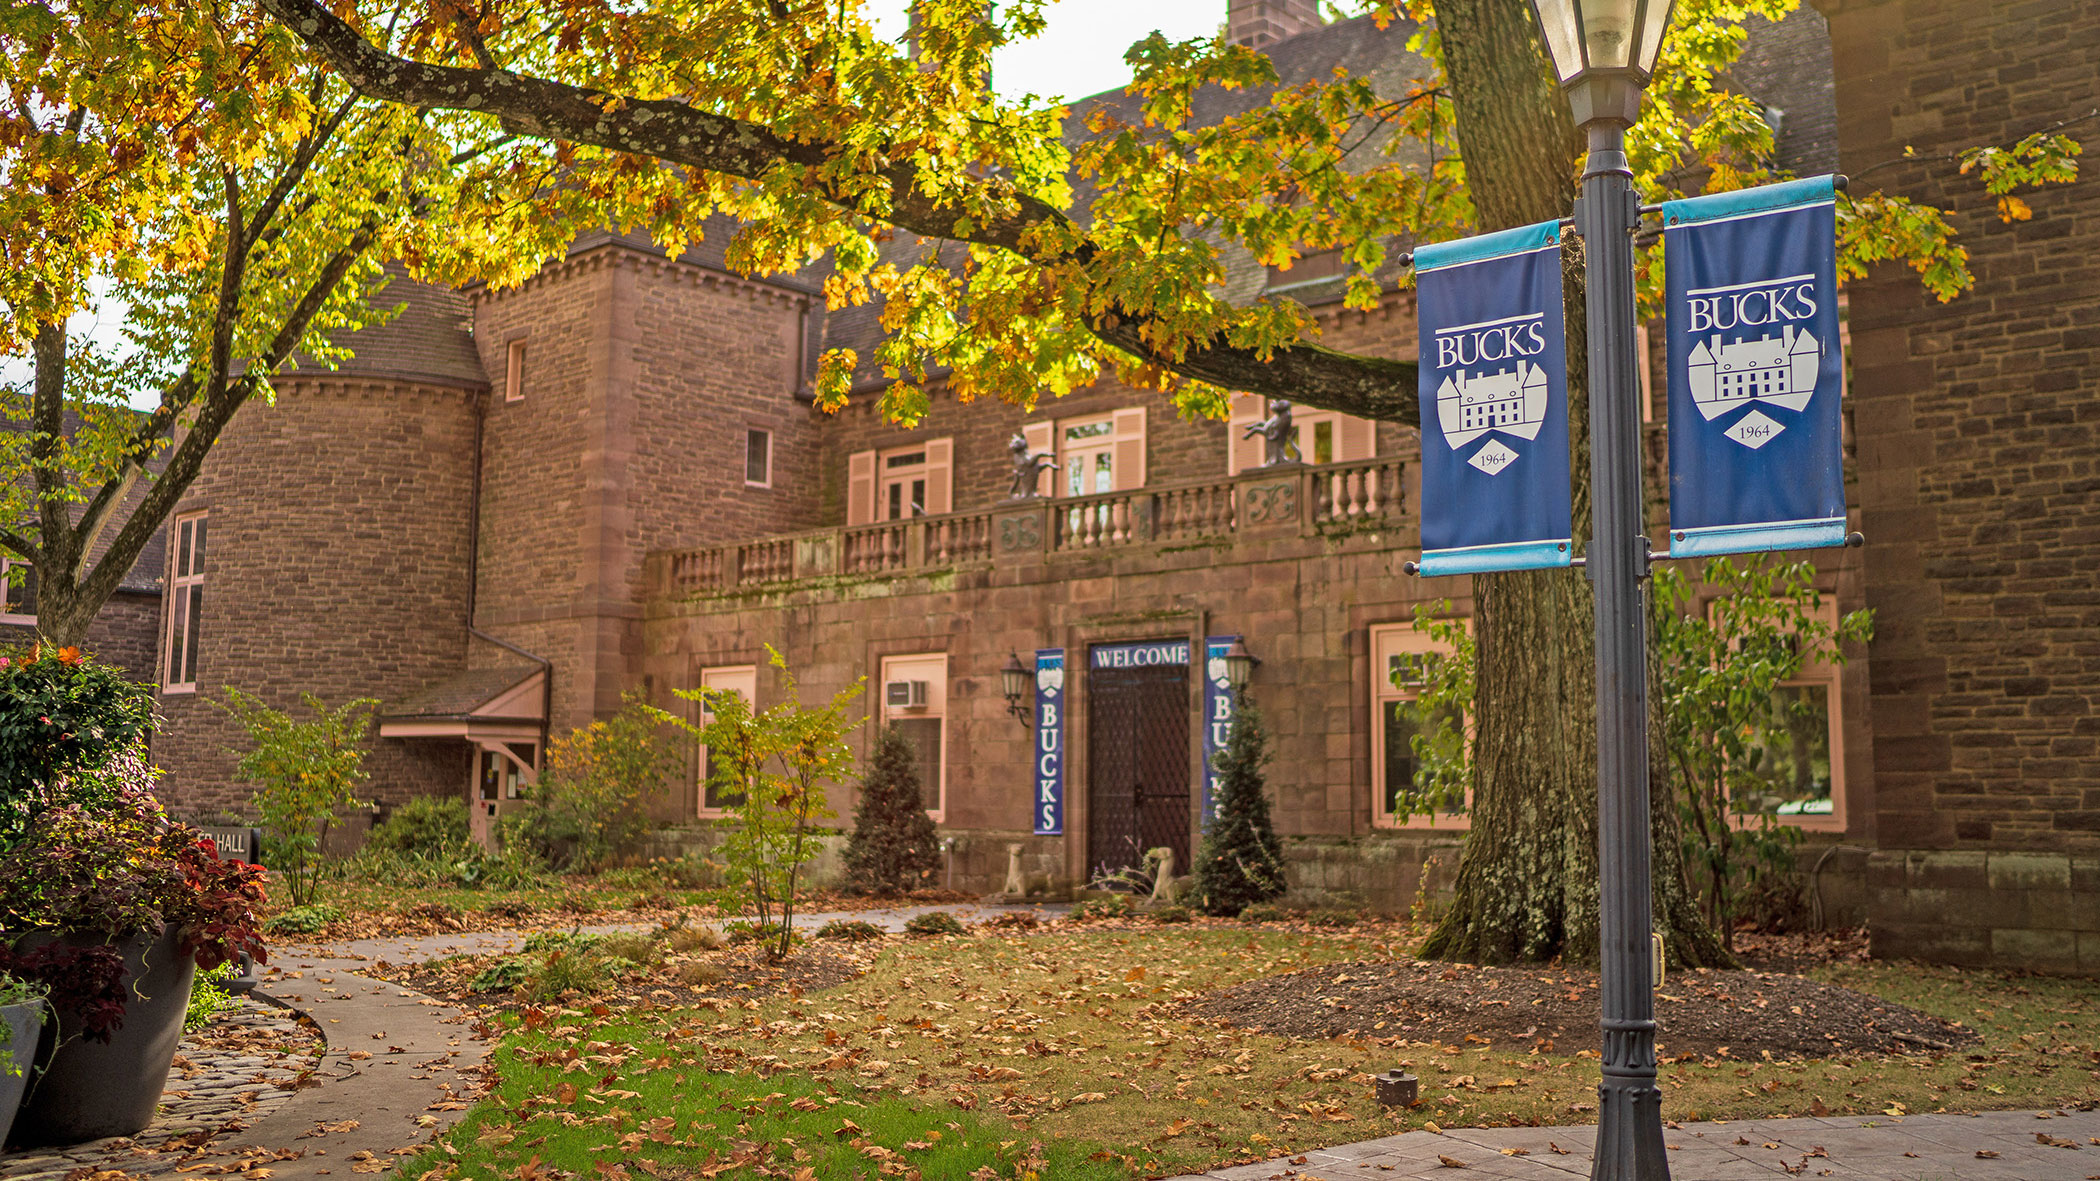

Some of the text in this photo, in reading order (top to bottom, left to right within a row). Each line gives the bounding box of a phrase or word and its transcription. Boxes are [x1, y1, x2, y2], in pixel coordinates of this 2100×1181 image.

[1687, 283, 1817, 332] BUCKS
[1435, 321, 1546, 368] BUCKS
[1739, 425, 1770, 439] 1964
[1480, 453, 1506, 466] 1964
[1096, 646, 1188, 667] WELCOME
[1040, 704, 1059, 830] BUCKS
[216, 833, 245, 853] HALL
